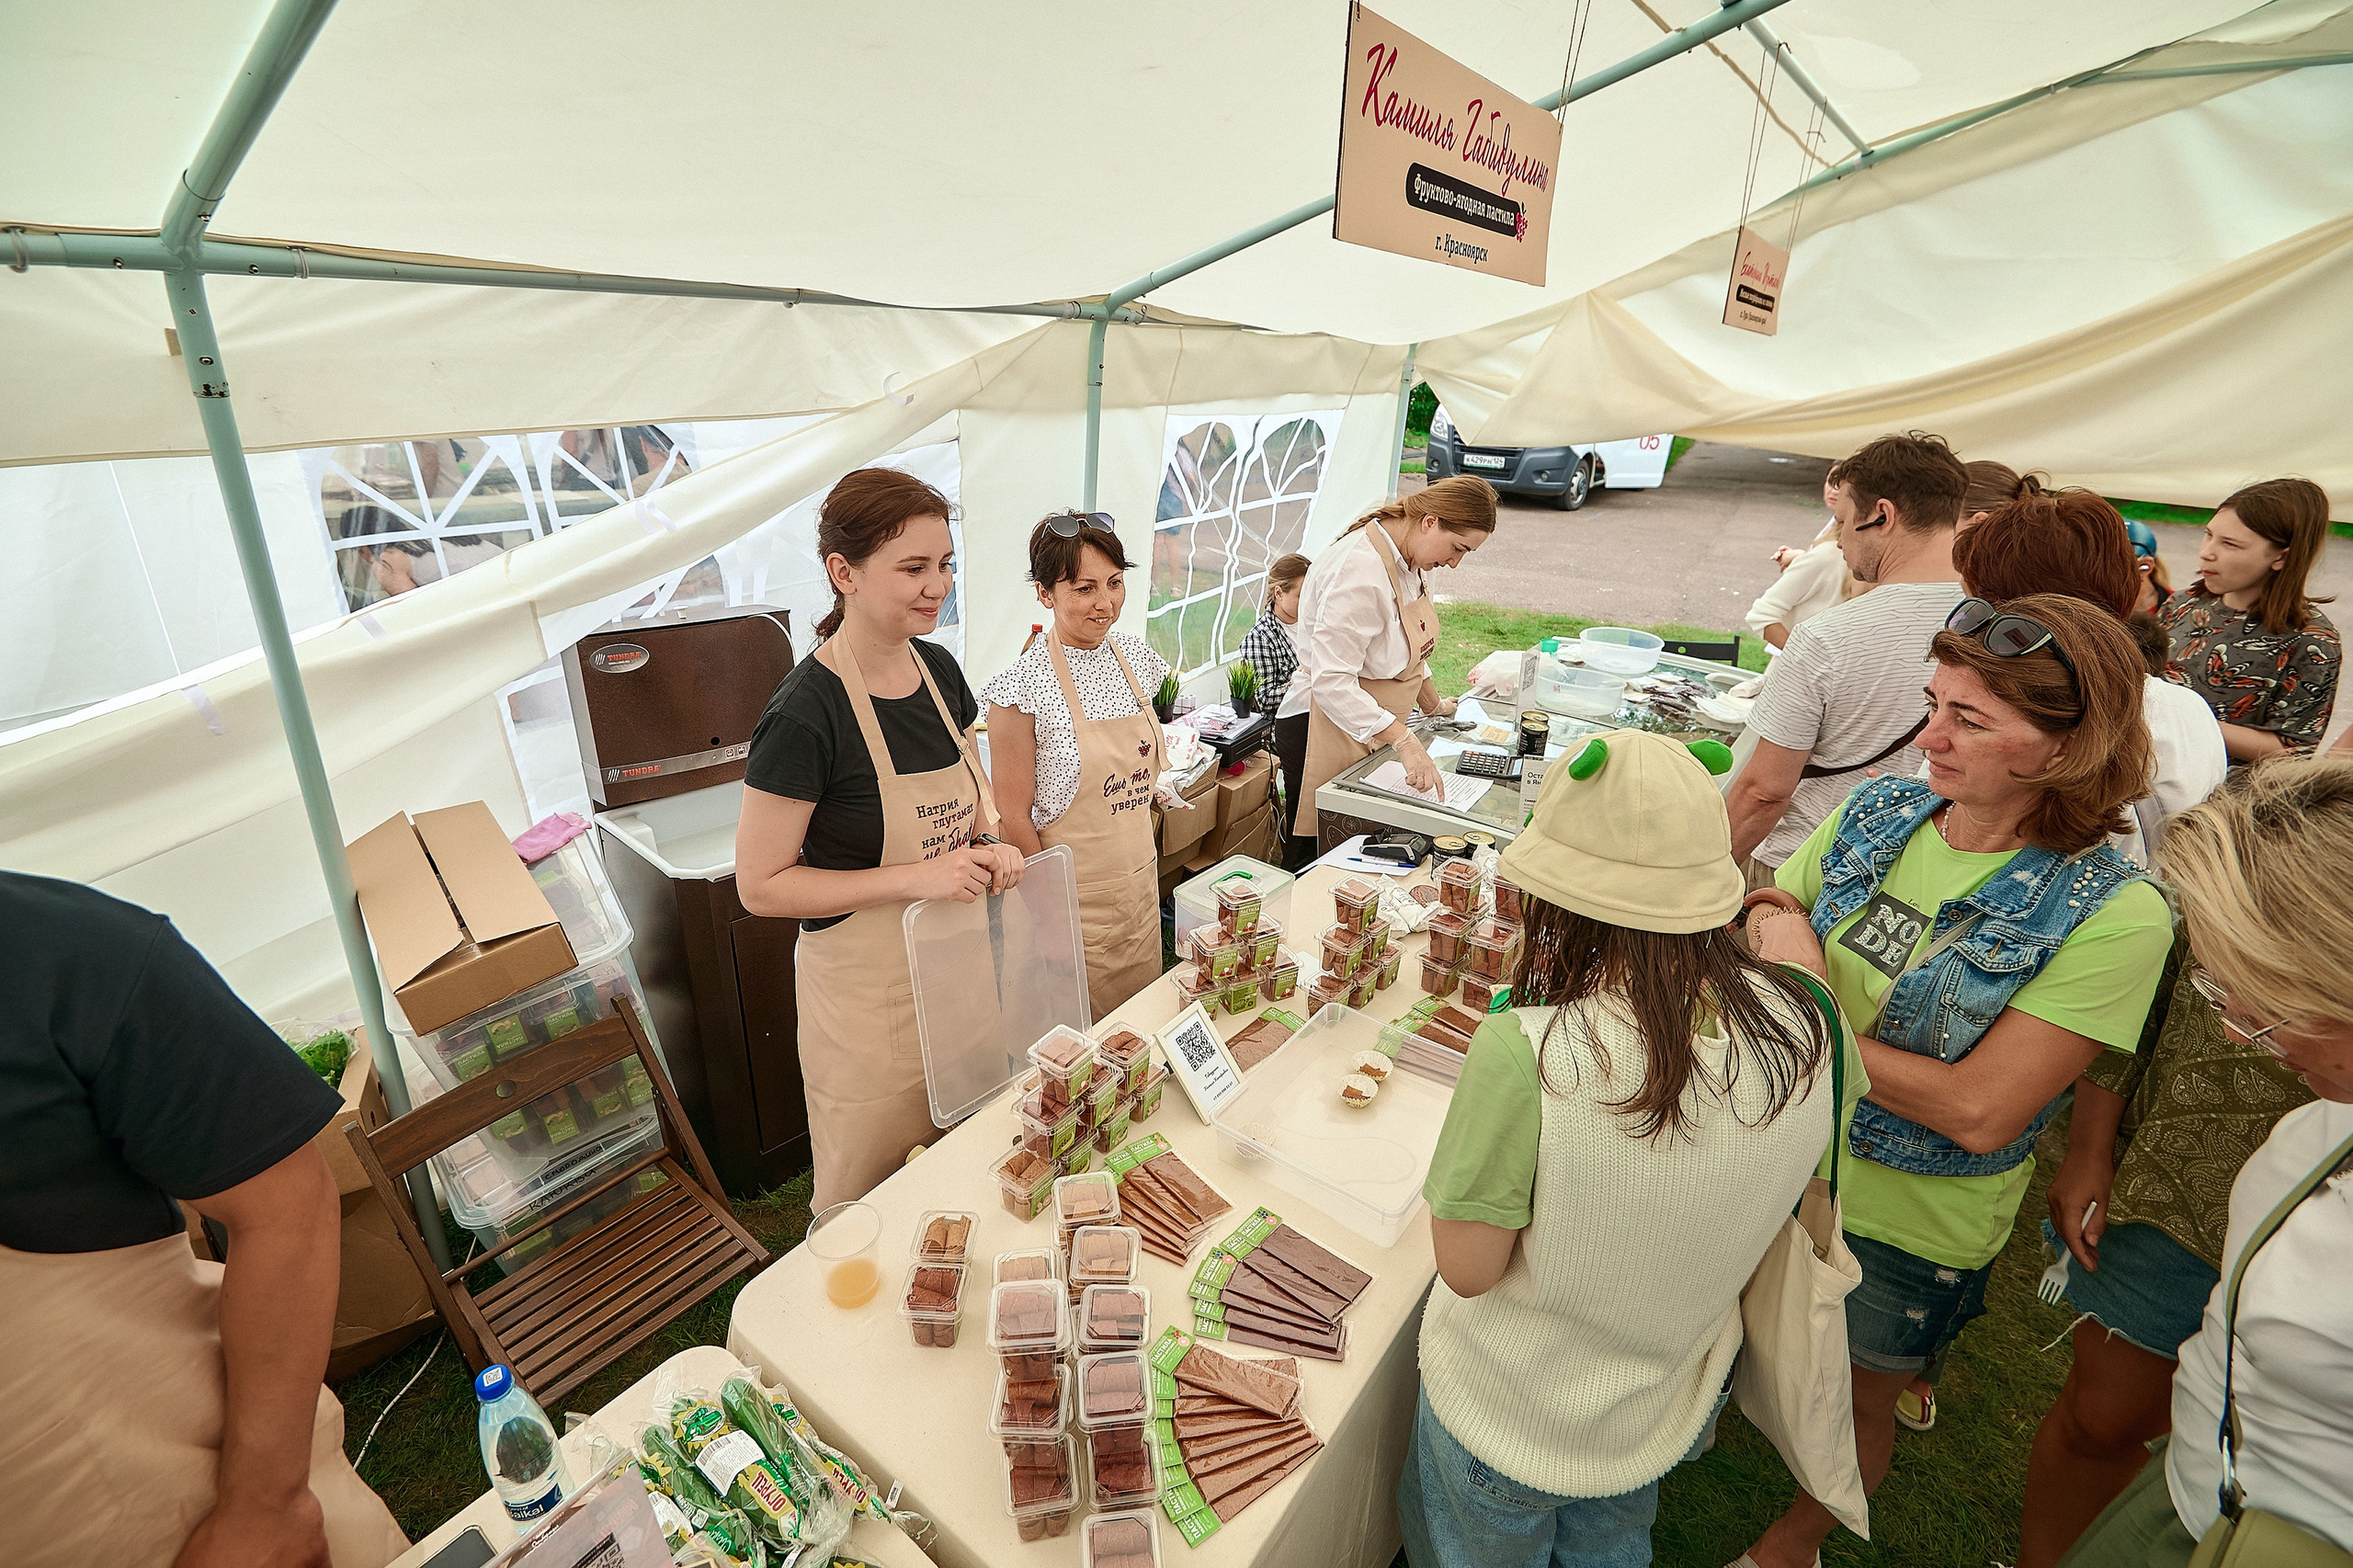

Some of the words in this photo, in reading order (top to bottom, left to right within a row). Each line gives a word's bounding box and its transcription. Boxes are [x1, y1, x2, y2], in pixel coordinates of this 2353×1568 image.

[1414, 173, 1486, 217] Фруктово-ягодная
[1485, 203, 1515, 226] пастила
[1435, 235, 1442, 251] г.
[1443, 233, 1489, 265] Красноярск
[607, 651, 642, 662] TUNDRA
[622, 765, 661, 778] TUNDRA
[1103, 773, 1127, 797] Ешь
[1134, 784, 1150, 795] чем
[915, 798, 960, 819] Натрия
[1110, 793, 1150, 816] уверен
[921, 834, 947, 850] нам
[1870, 903, 1923, 944] NO
[1130, 1139, 1154, 1153] ПАСТИЛА
[1241, 1217, 1263, 1236] ПАСТИЛА
[1202, 1258, 1219, 1280] ПАСТИЛА
[1151, 1337, 1174, 1363] ПАСТИЛА
[751, 1470, 787, 1513] ОГУРЕЦ
